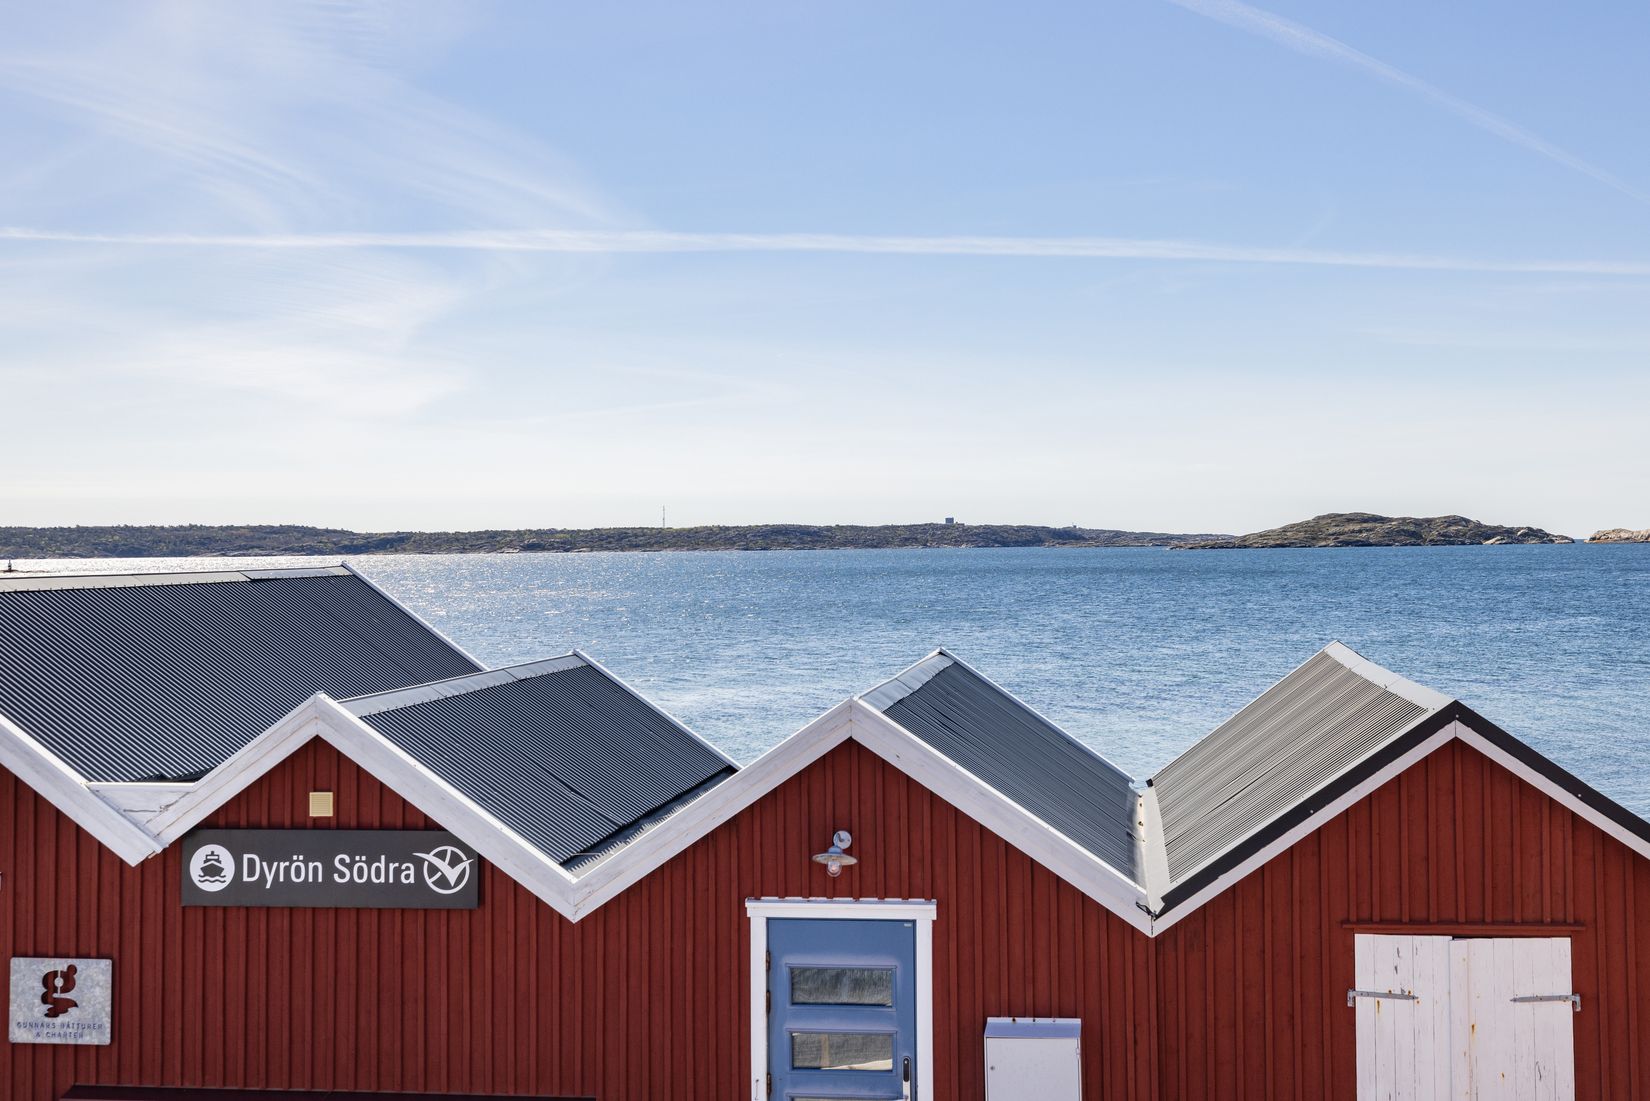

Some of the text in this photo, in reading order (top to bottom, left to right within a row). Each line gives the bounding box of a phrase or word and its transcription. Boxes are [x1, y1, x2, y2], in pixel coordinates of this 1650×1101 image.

[242, 854, 415, 889] Dyrön Södra
[16, 1021, 56, 1029] GUNNARS
